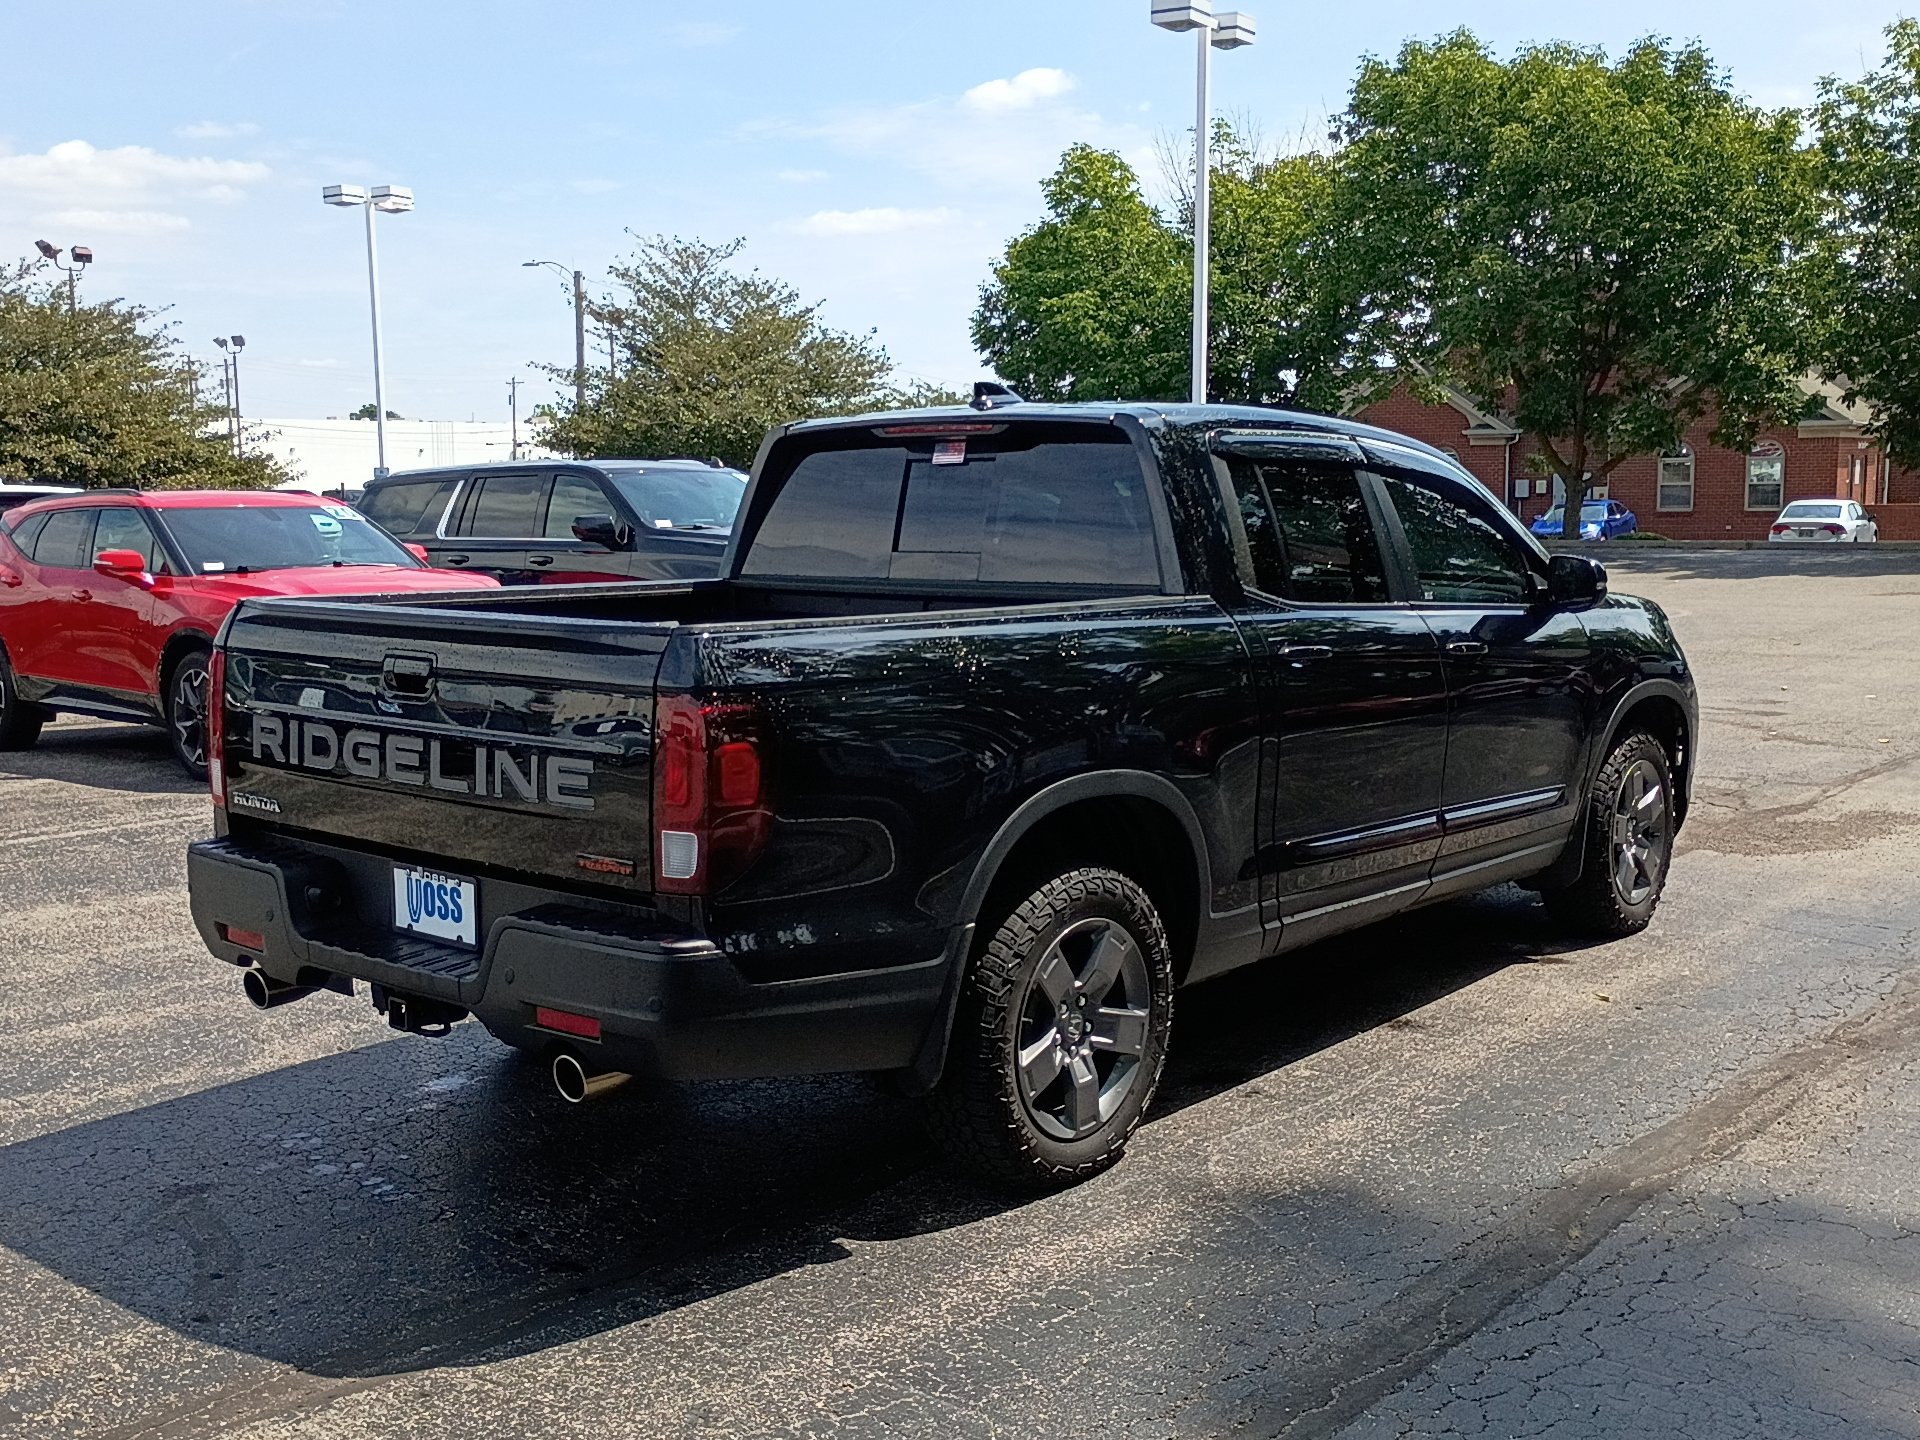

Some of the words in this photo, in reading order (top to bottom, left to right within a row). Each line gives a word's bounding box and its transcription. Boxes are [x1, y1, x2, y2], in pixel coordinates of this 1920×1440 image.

[252, 714, 595, 811] RIDGELINE
[232, 791, 281, 813] HONDA
[406, 876, 463, 924] VOSS
